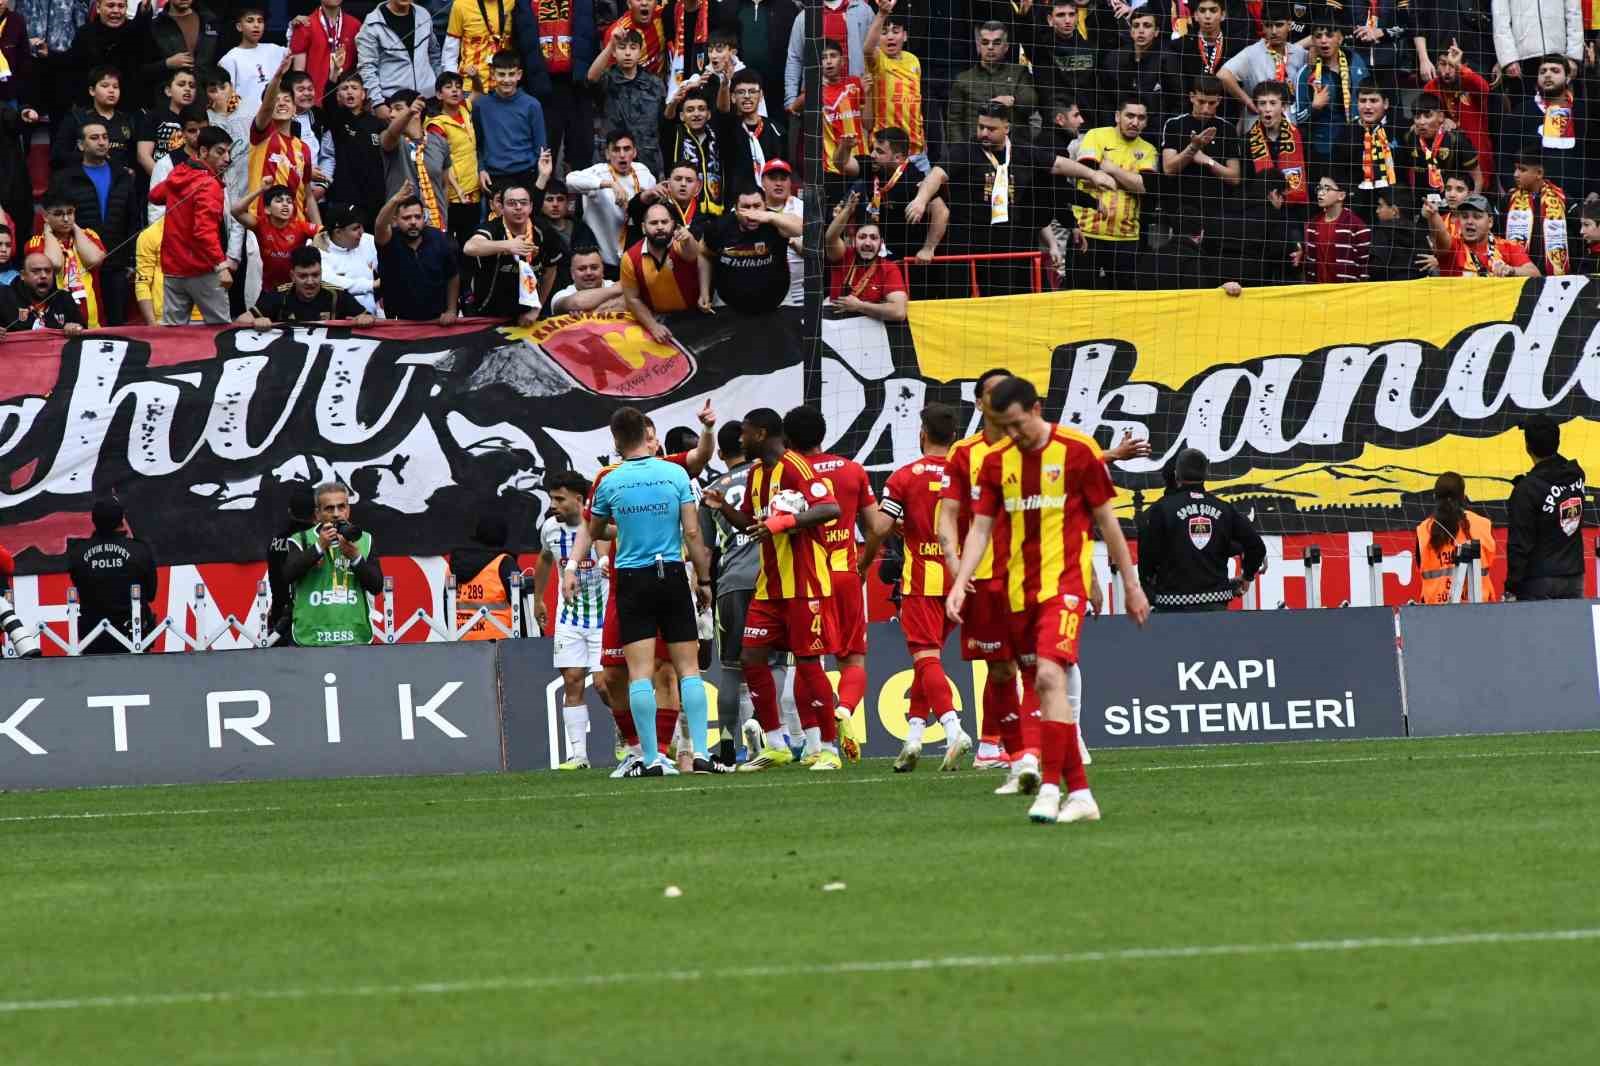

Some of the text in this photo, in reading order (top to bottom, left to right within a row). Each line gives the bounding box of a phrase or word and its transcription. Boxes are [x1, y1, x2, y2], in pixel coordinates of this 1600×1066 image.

[316, 631, 354, 642] PRESS
[810, 614, 823, 636] 4
[1058, 608, 1079, 641] 18
[1177, 658, 1277, 691] KAPI
[1104, 691, 1356, 735] SİSTEMLERİ
